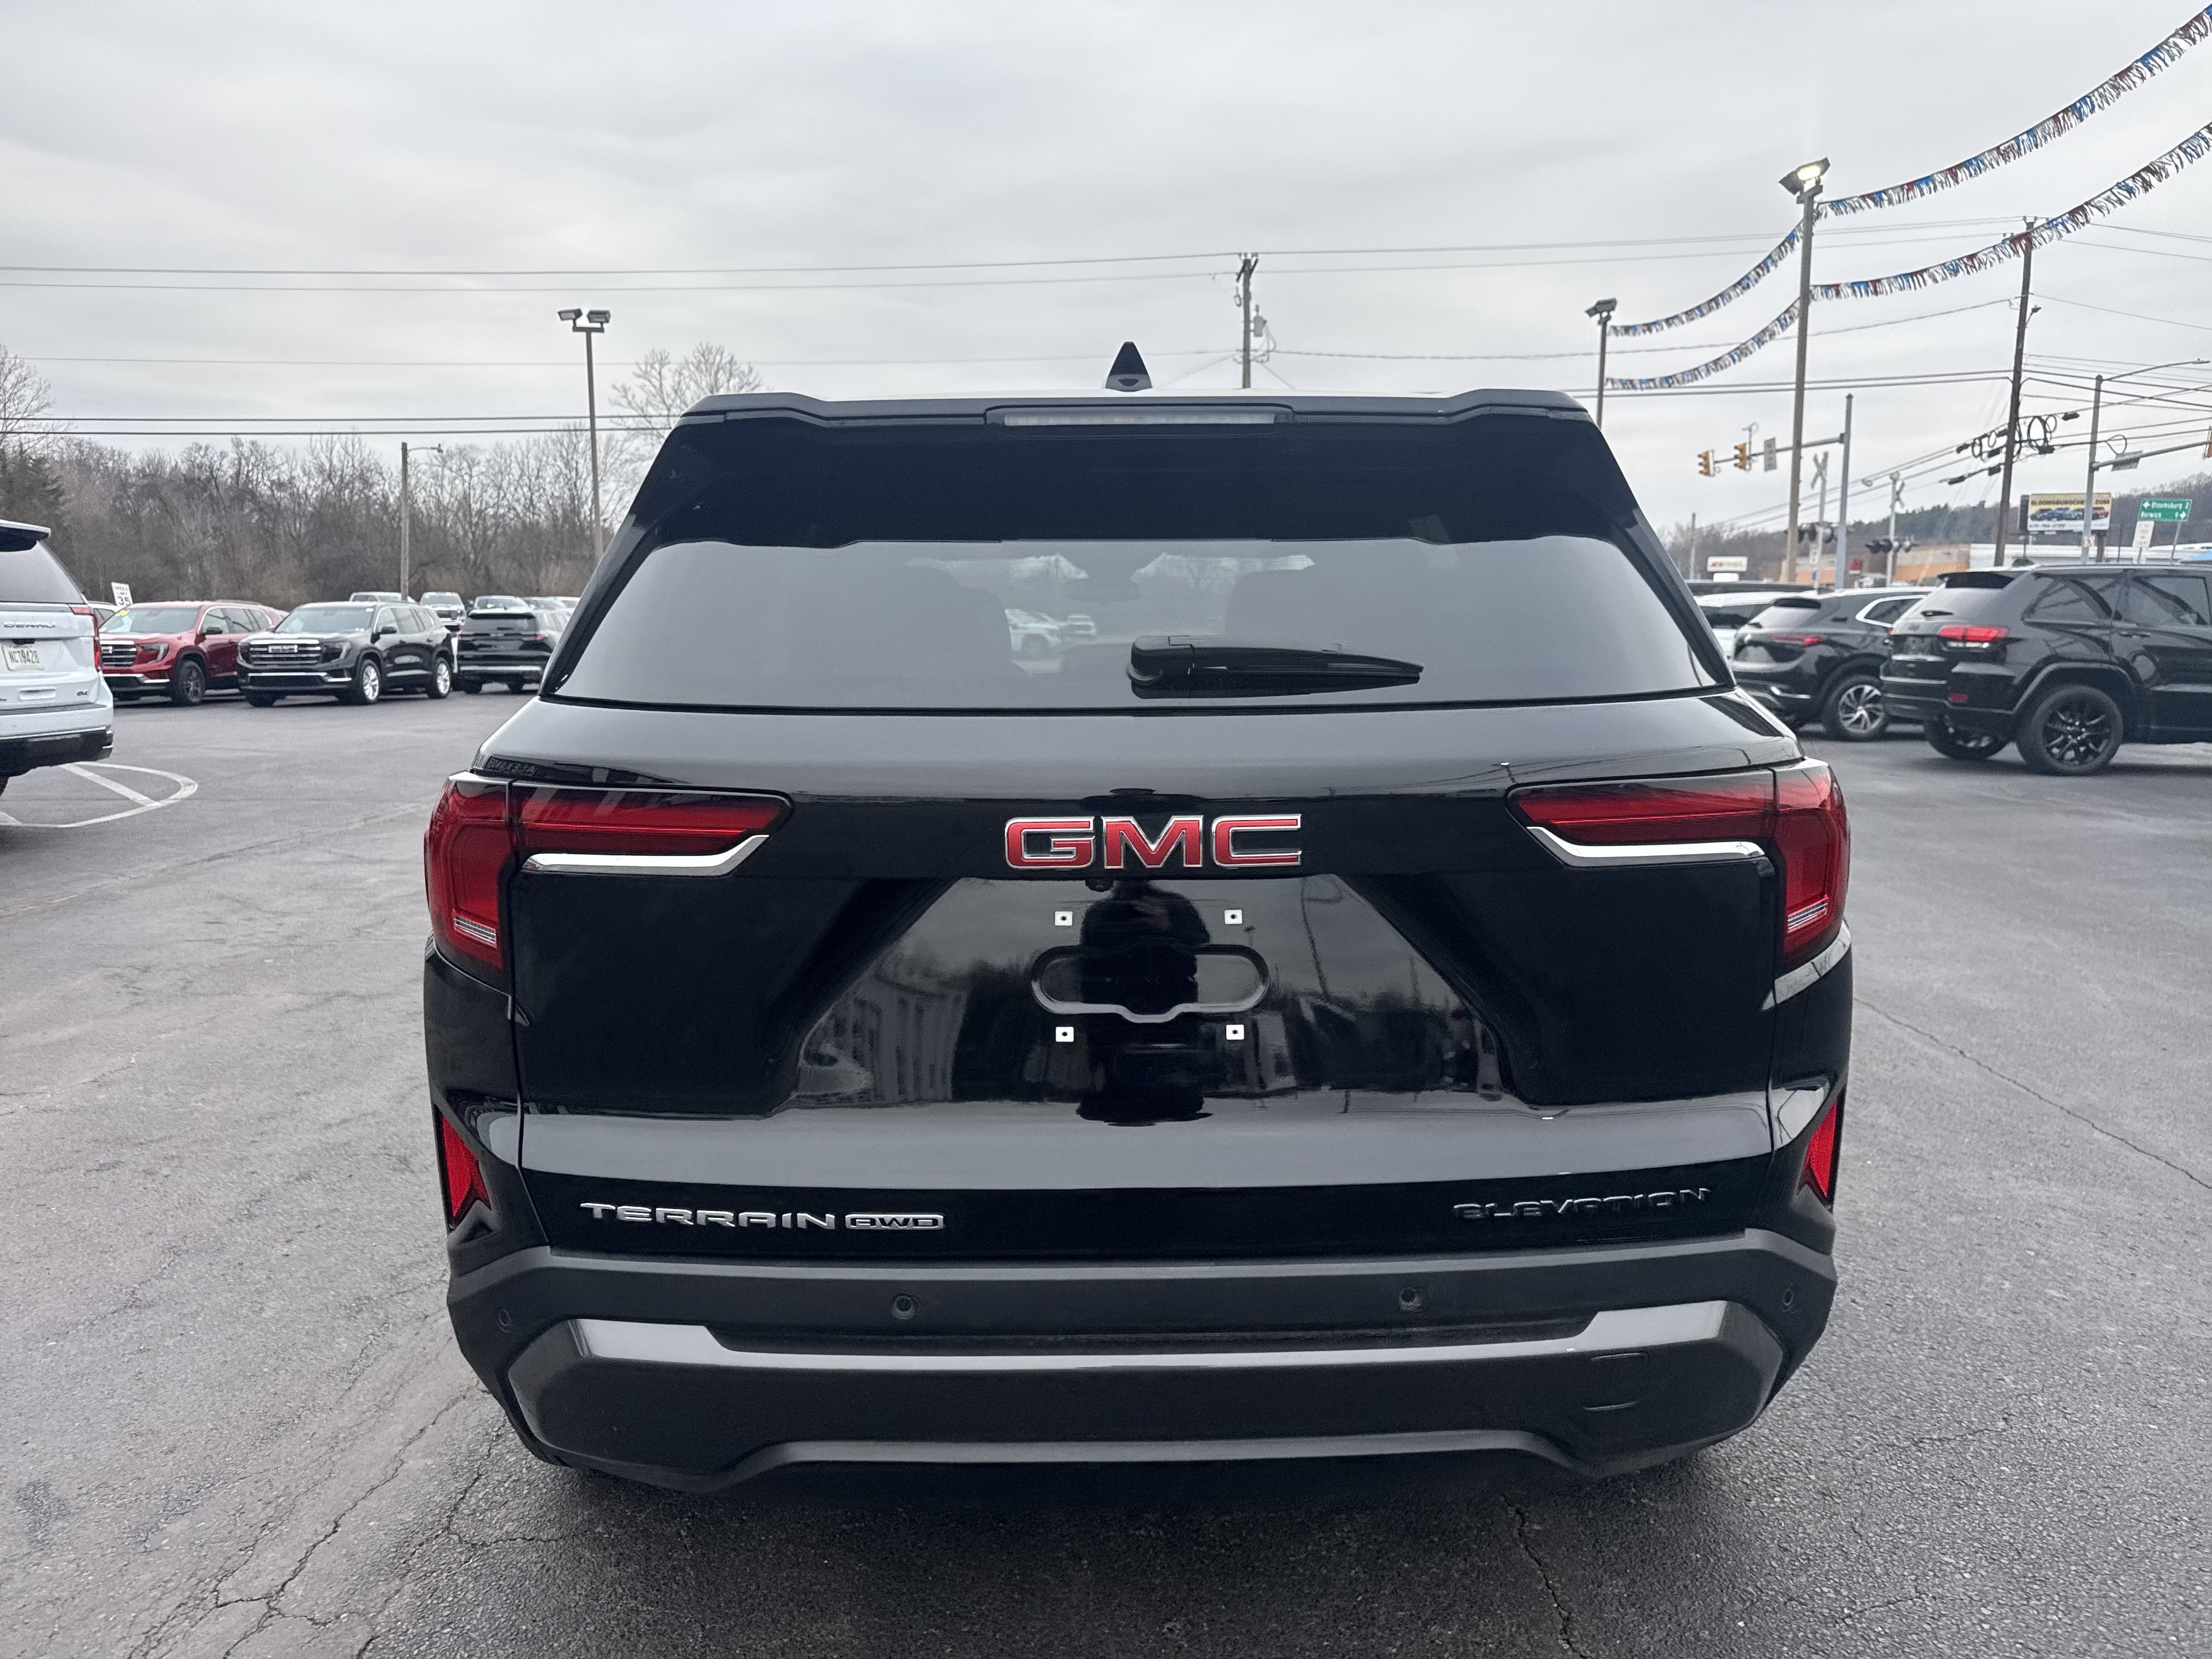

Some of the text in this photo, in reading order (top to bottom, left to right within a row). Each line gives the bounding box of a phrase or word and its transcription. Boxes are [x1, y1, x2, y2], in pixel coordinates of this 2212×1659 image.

[2151, 501, 2183, 510] Bloomsburg
[117, 596, 131, 607] 35
[1005, 814, 1302, 870] GMC
[580, 1202, 943, 1230] TERRAIN AWD
[1453, 1187, 1711, 1220] ELEVATION
